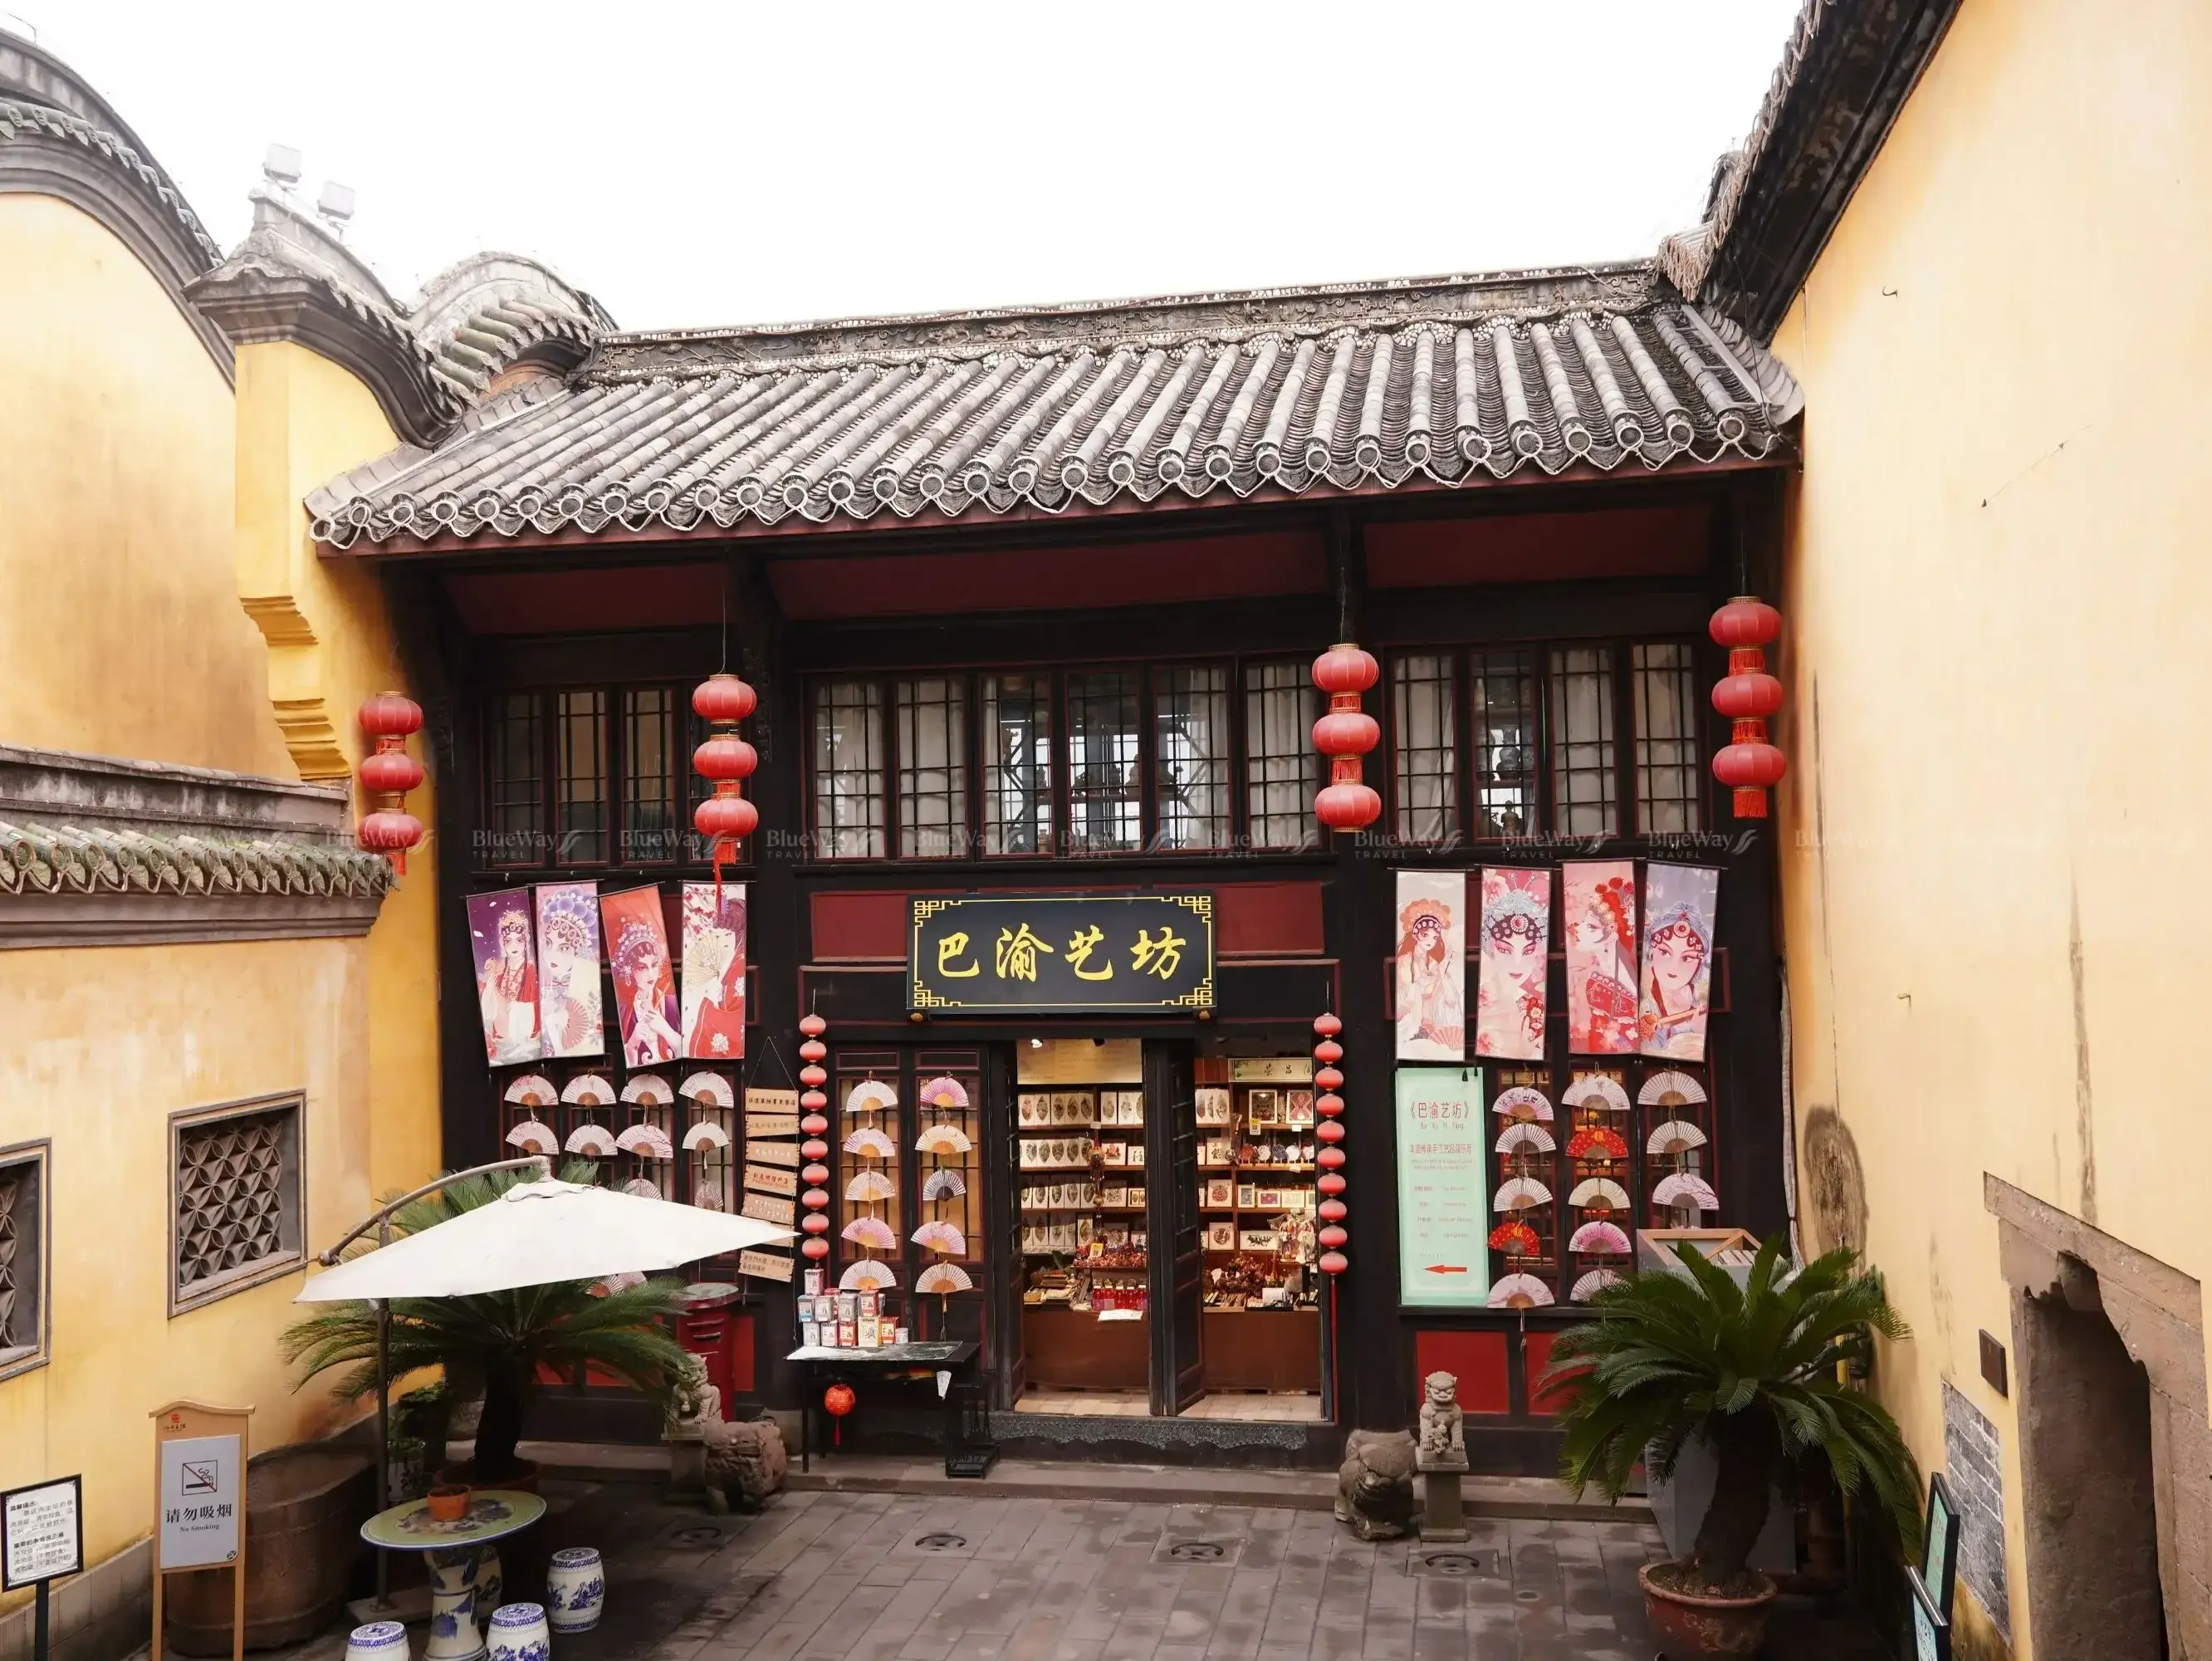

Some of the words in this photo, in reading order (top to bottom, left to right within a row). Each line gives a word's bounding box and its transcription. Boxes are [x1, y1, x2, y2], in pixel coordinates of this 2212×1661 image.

[937, 923, 1187, 982] 巴渝艺坊
[1411, 1101, 1470, 1119] 《巴渝艺坊》
[166, 1503, 232, 1523] 请勿吸烟
[191, 1523, 220, 1532] Smoking
